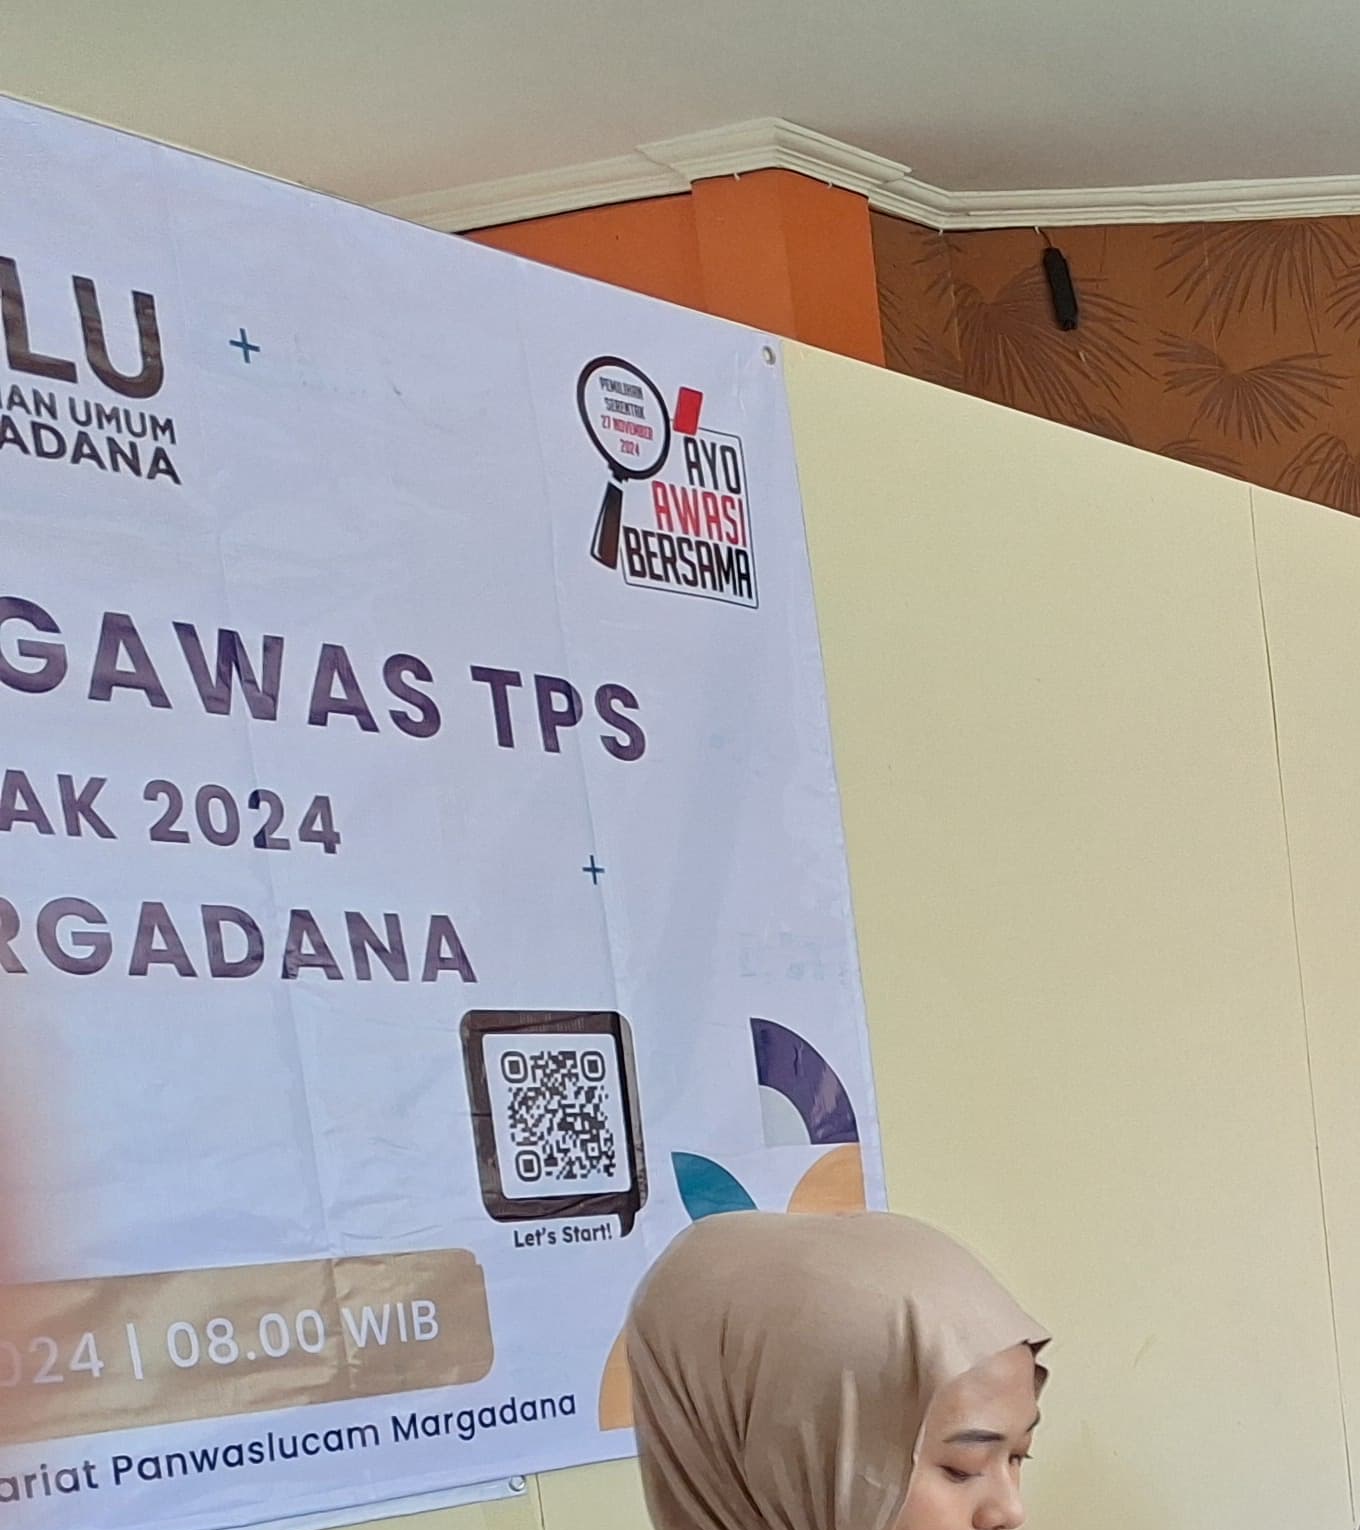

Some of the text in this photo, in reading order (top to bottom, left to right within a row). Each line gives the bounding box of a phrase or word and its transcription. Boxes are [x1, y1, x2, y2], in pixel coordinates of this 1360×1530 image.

[0, 384, 176, 445] AN UMUM
[600, 377, 643, 400] PEMILIHAN
[0, 415, 182, 485] ADANA
[601, 415, 654, 441] 27 NOVEMBER
[620, 439, 640, 457] 2024
[683, 436, 742, 495] AYO
[652, 480, 747, 548] AWASI
[623, 526, 753, 600] BERSAMA
[470, 665, 646, 761] TPS
[143, 780, 340, 854] 2024
[514, 1222, 612, 1248] Let's Start!
[166, 1308, 326, 1369] 08.00
[342, 1299, 440, 1349] WIB
[112, 1421, 381, 1487] Panwaslucam
[392, 1392, 577, 1442] Margadana
